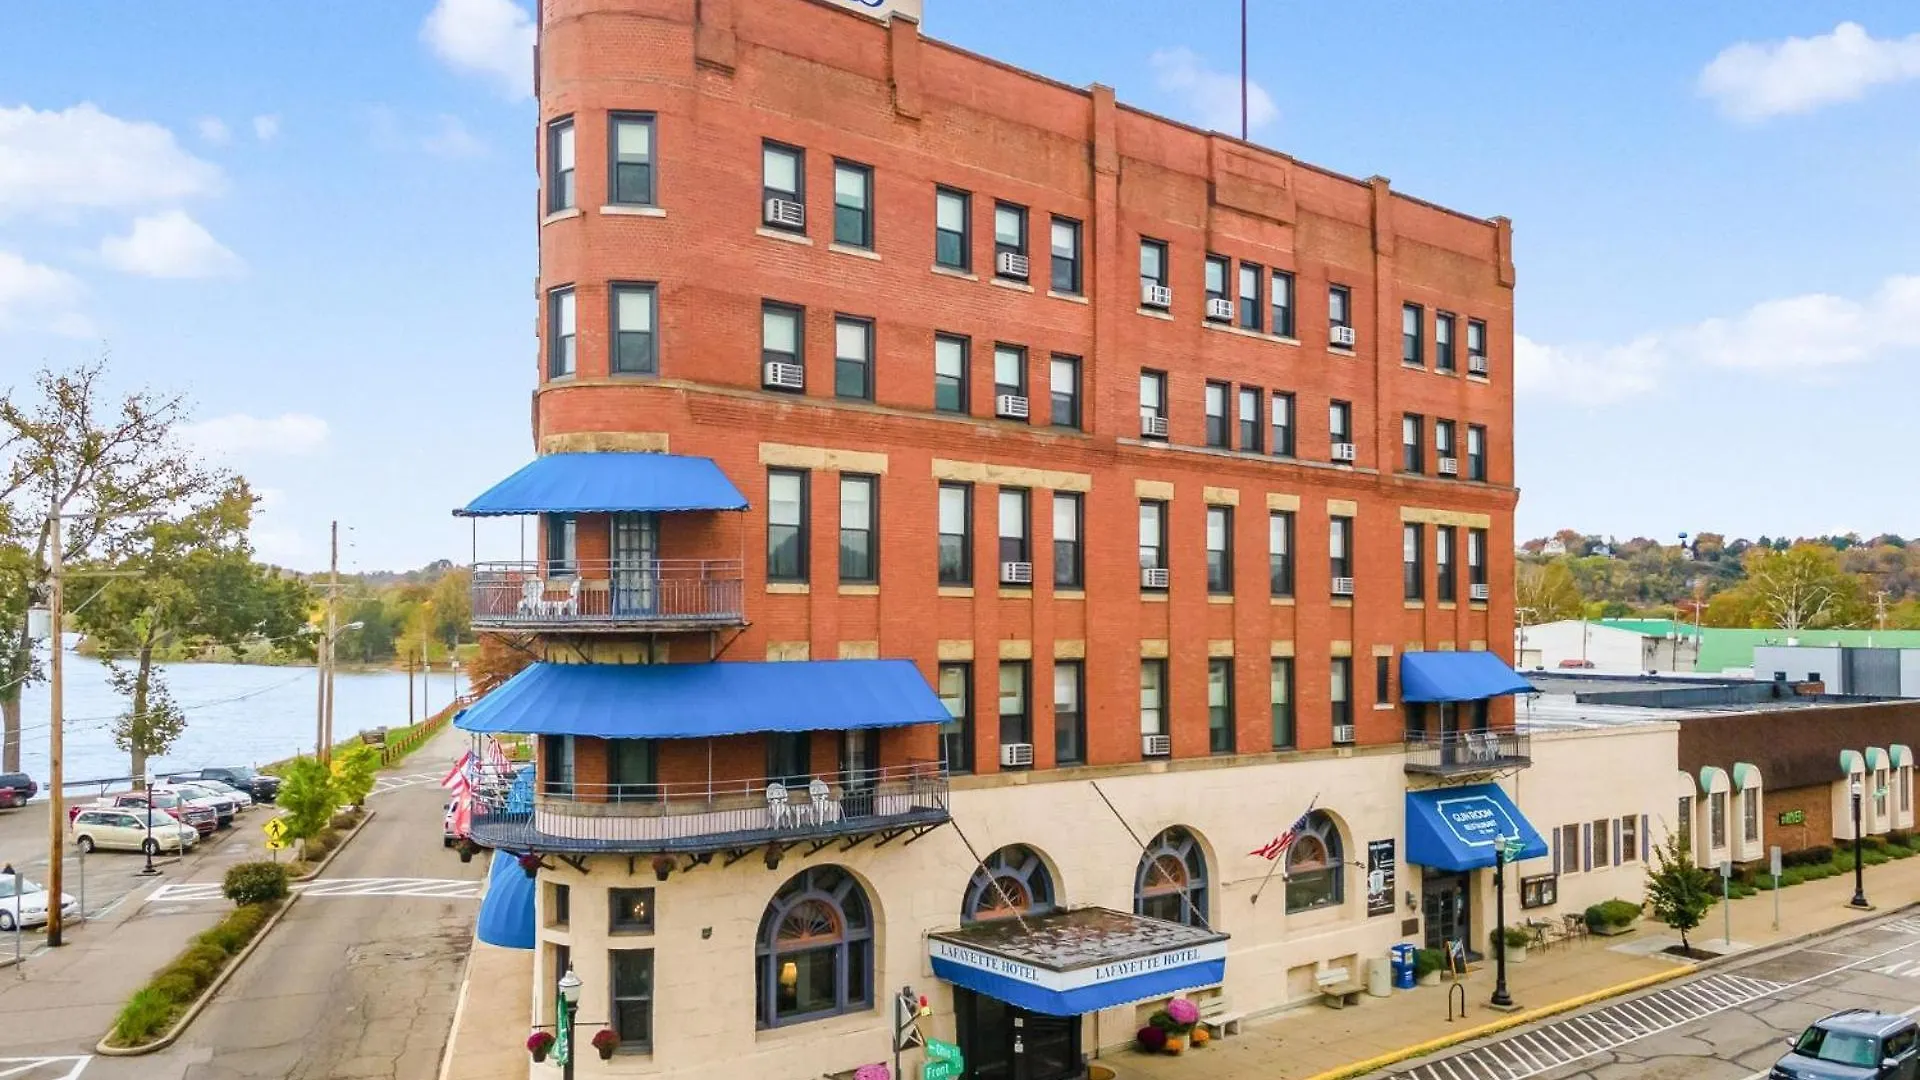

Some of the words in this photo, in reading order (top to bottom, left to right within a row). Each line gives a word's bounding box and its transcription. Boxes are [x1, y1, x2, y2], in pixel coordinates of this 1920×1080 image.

[941, 944, 998, 969] LAFAYETTE
[1001, 961, 1040, 981] HOTEL
[1096, 957, 1160, 980] LAFAYETTE
[1164, 948, 1200, 966] HOTEL
